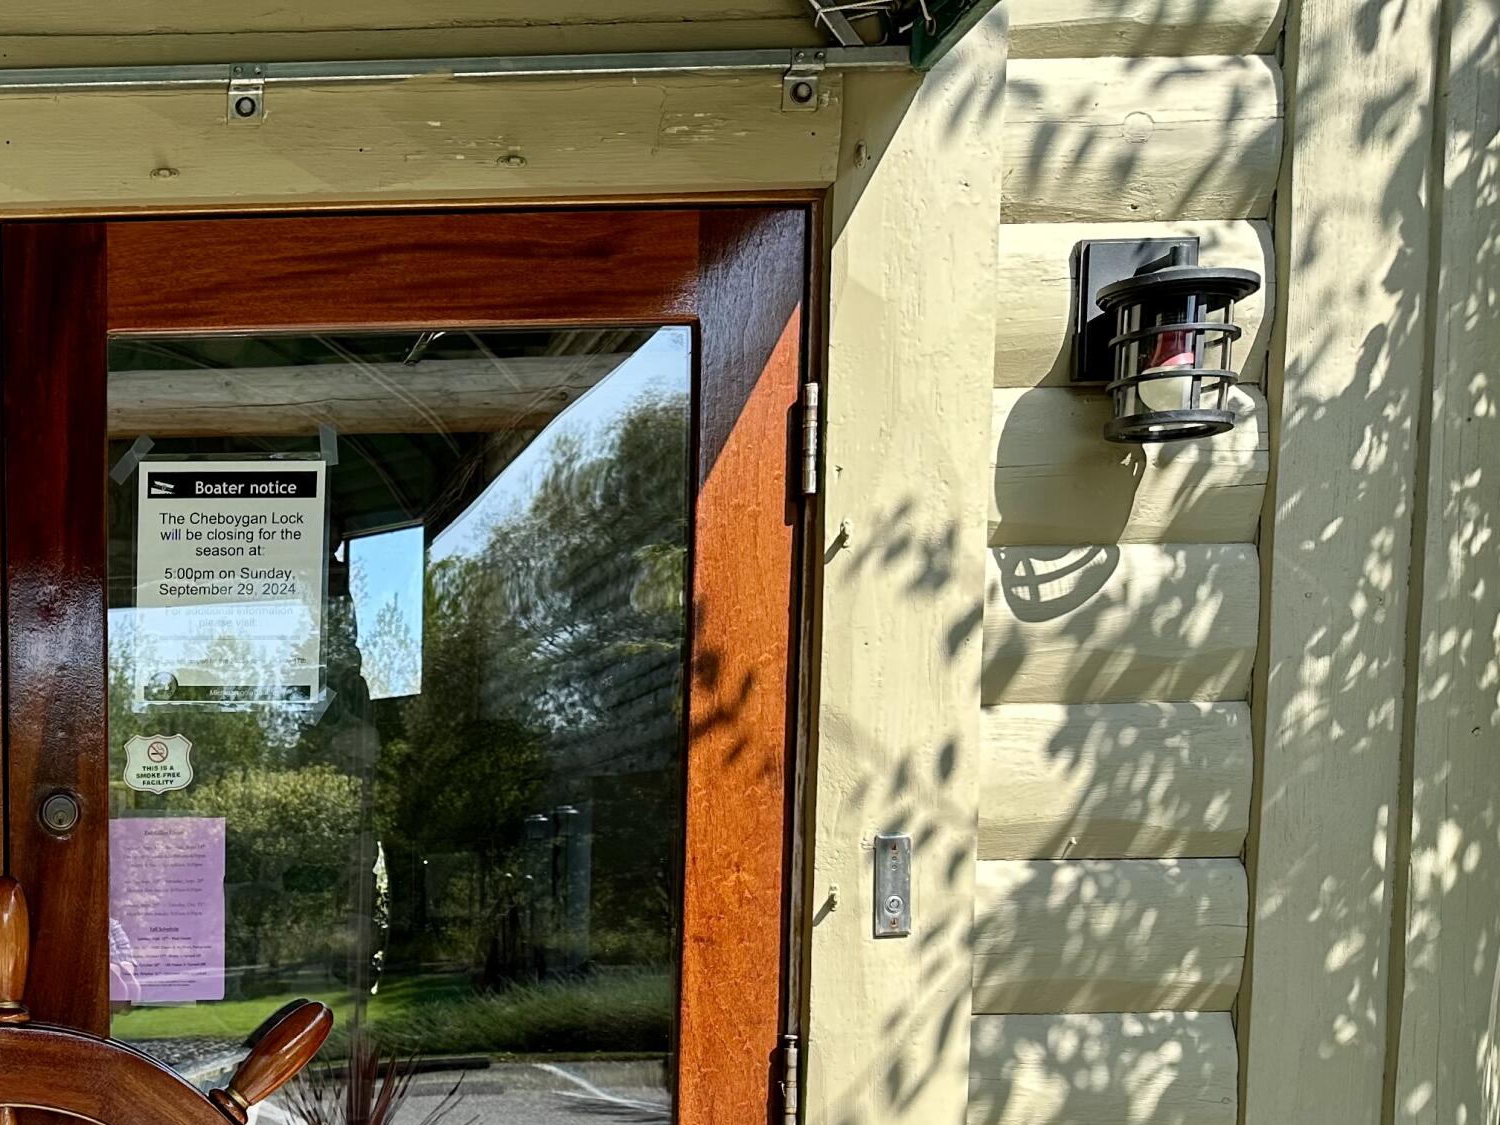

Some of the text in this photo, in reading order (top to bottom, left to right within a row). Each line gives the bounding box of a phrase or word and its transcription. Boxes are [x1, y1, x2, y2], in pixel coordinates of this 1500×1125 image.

[195, 481, 297, 494] Boater notice
[159, 512, 304, 528] The Cheboygan Lock
[160, 528, 302, 543] will be closing for the
[195, 545, 244, 557] season
[164, 567, 296, 582] 5:00pm on Sunday,
[159, 583, 233, 598] September
